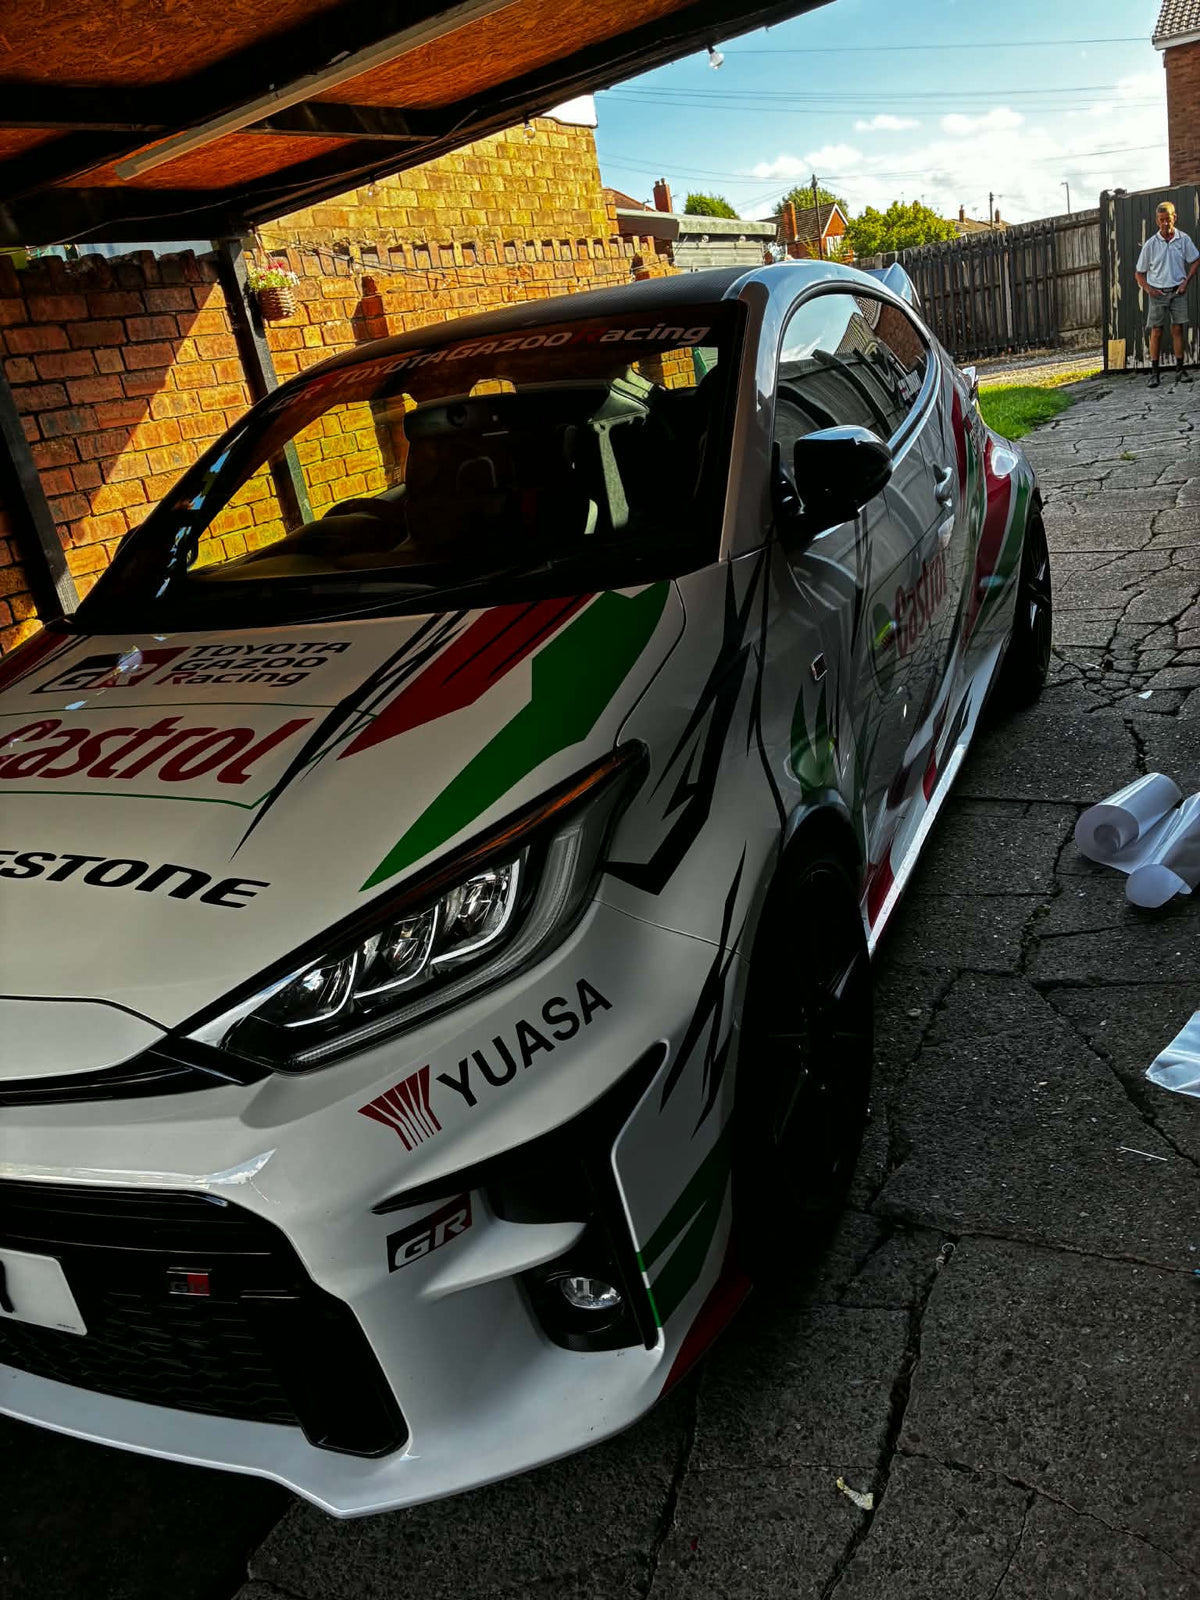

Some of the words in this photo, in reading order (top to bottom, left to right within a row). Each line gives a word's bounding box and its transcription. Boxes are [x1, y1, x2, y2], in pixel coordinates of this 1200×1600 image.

[333, 353, 446, 388] TOYOTA
[447, 331, 572, 361] GAZOO
[569, 323, 712, 346] Racing
[153, 669, 312, 687] Racing
[171, 657, 328, 672] GAZOO
[189, 642, 352, 658] TOYOTA
[0, 716, 315, 784] Castrol
[435, 978, 613, 1107] YUASA
[394, 1206, 472, 1268] GR
